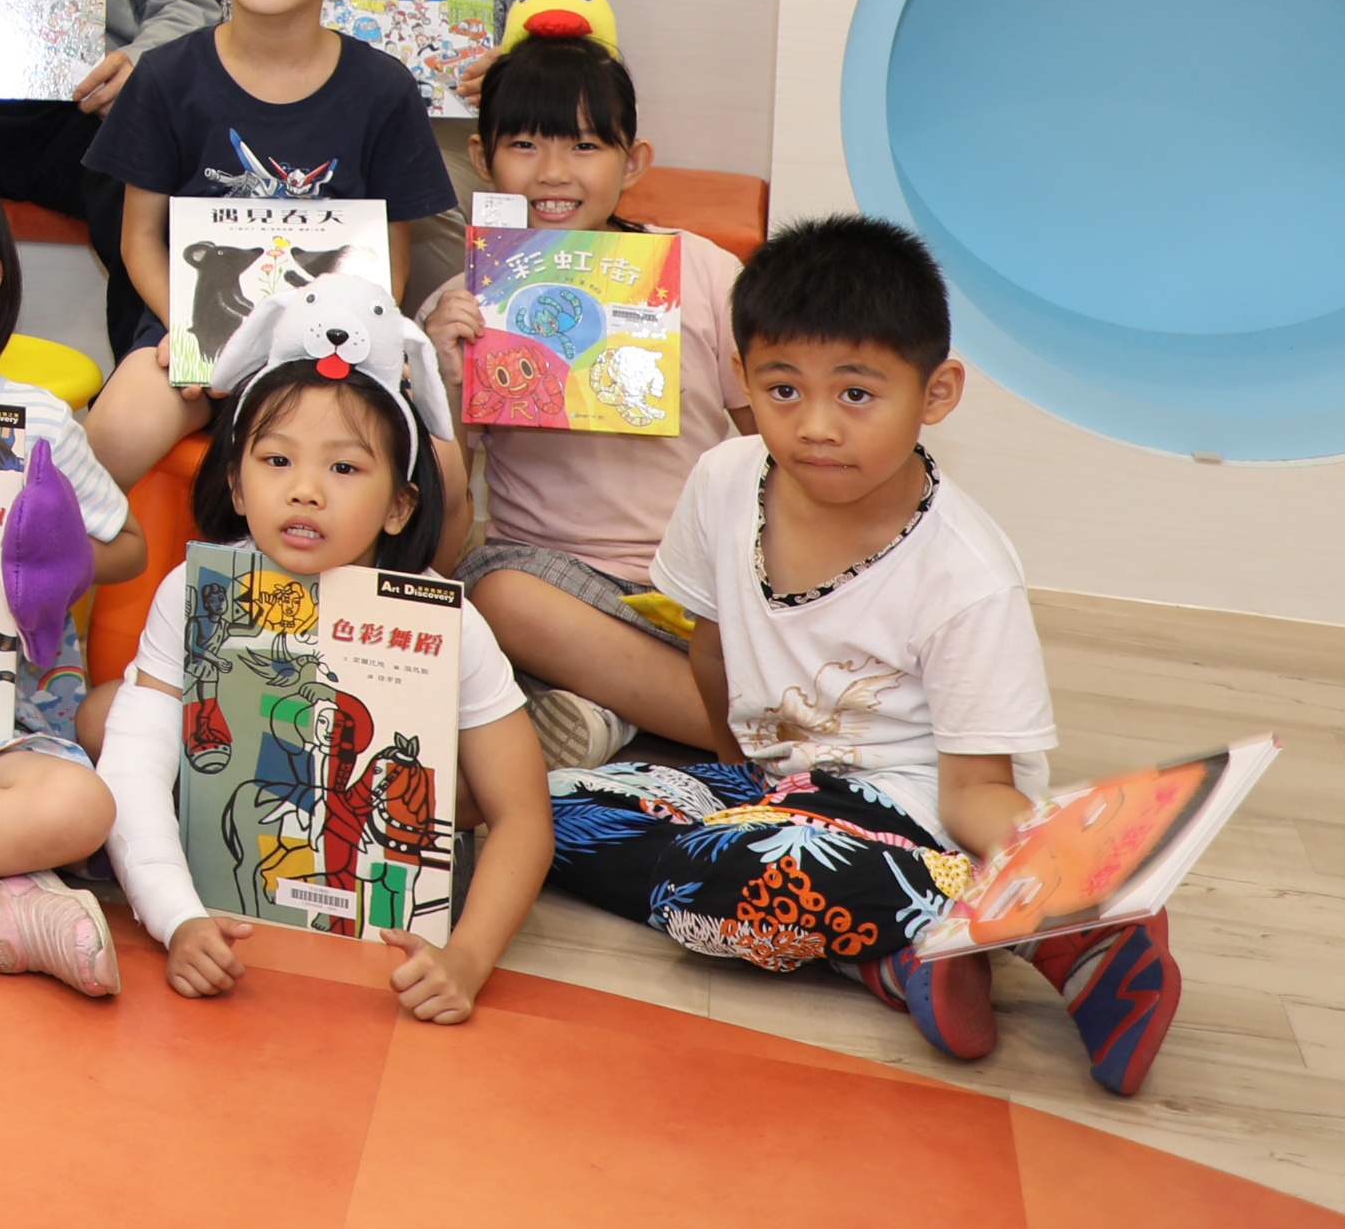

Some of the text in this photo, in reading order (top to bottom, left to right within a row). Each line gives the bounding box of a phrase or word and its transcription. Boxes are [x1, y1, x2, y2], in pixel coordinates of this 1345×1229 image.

[211, 208, 345, 225] 遇見春天
[506, 250, 642, 286] 彩虹街
[381, 581, 399, 593] Art
[404, 584, 455, 603] Discovery
[332, 618, 443, 657] 色彩舞蹈
